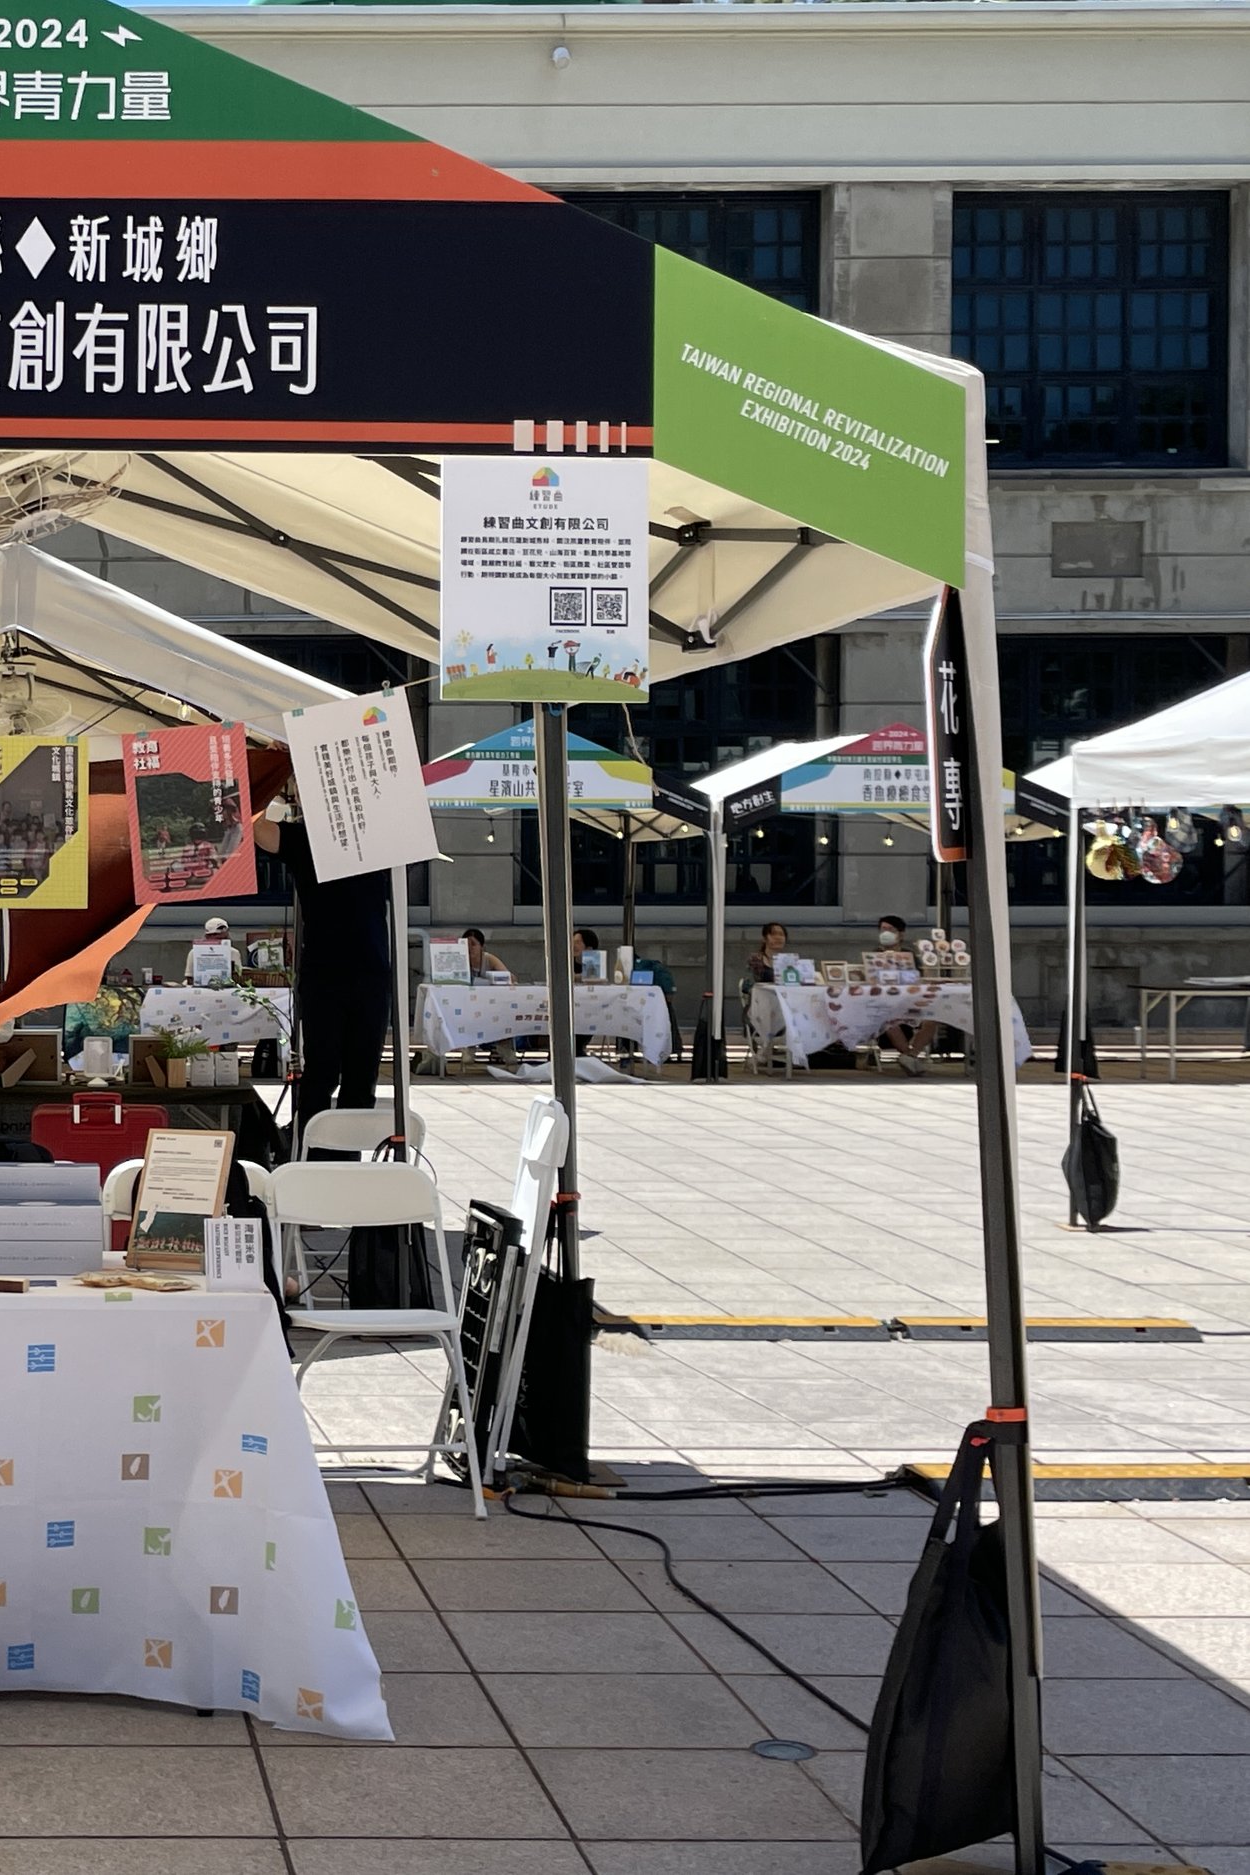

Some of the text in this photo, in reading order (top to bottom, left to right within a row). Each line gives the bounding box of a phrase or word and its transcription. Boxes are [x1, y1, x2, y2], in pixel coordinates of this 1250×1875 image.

[68, 215, 219, 283] 新城鄉
[681, 343, 949, 478] TAIWAN REGIONAL REVITALIZATION
[740, 399, 872, 471] EXHIBITION 2024
[484, 516, 609, 531] 練習曲文創有限公司
[502, 764, 530, 777] 基隆市
[730, 790, 775, 814] 地方創生
